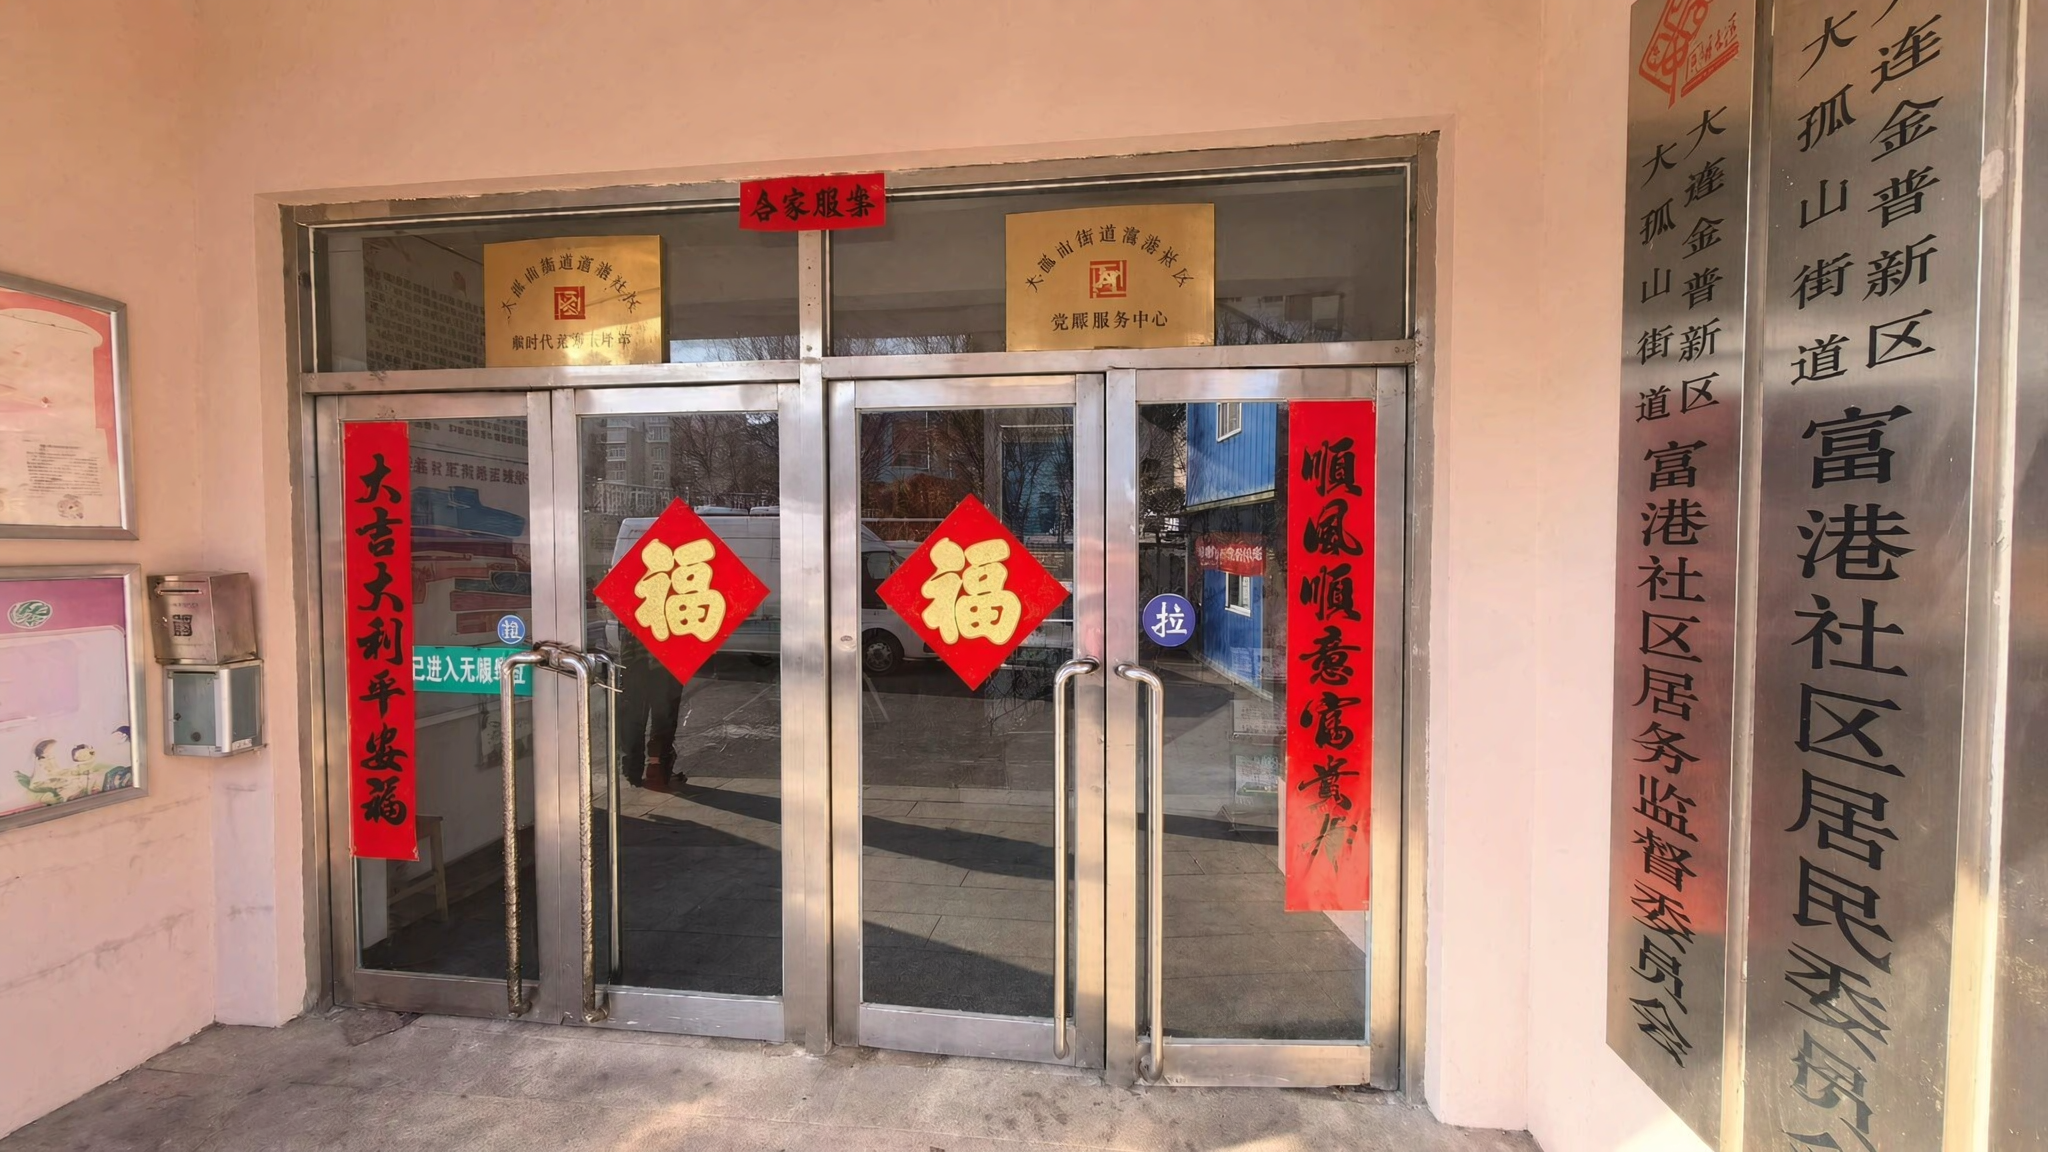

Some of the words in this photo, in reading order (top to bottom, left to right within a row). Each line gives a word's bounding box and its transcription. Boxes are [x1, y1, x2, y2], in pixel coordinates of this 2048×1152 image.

[1635, 142, 1678, 423] 大孤山街道
[1678, 105, 1728, 414] 大连金普新区
[1791, 11, 1857, 386] 大孤山街道
[1863, 0, 1944, 369] 连金普新区
[354, 453, 409, 827] 大吉大利平安福
[633, 537, 727, 643] 福
[919, 536, 1023, 646] 福
[1151, 601, 1189, 638] 拉
[1629, 439, 1709, 1069] 富港社区居务监督委员会
